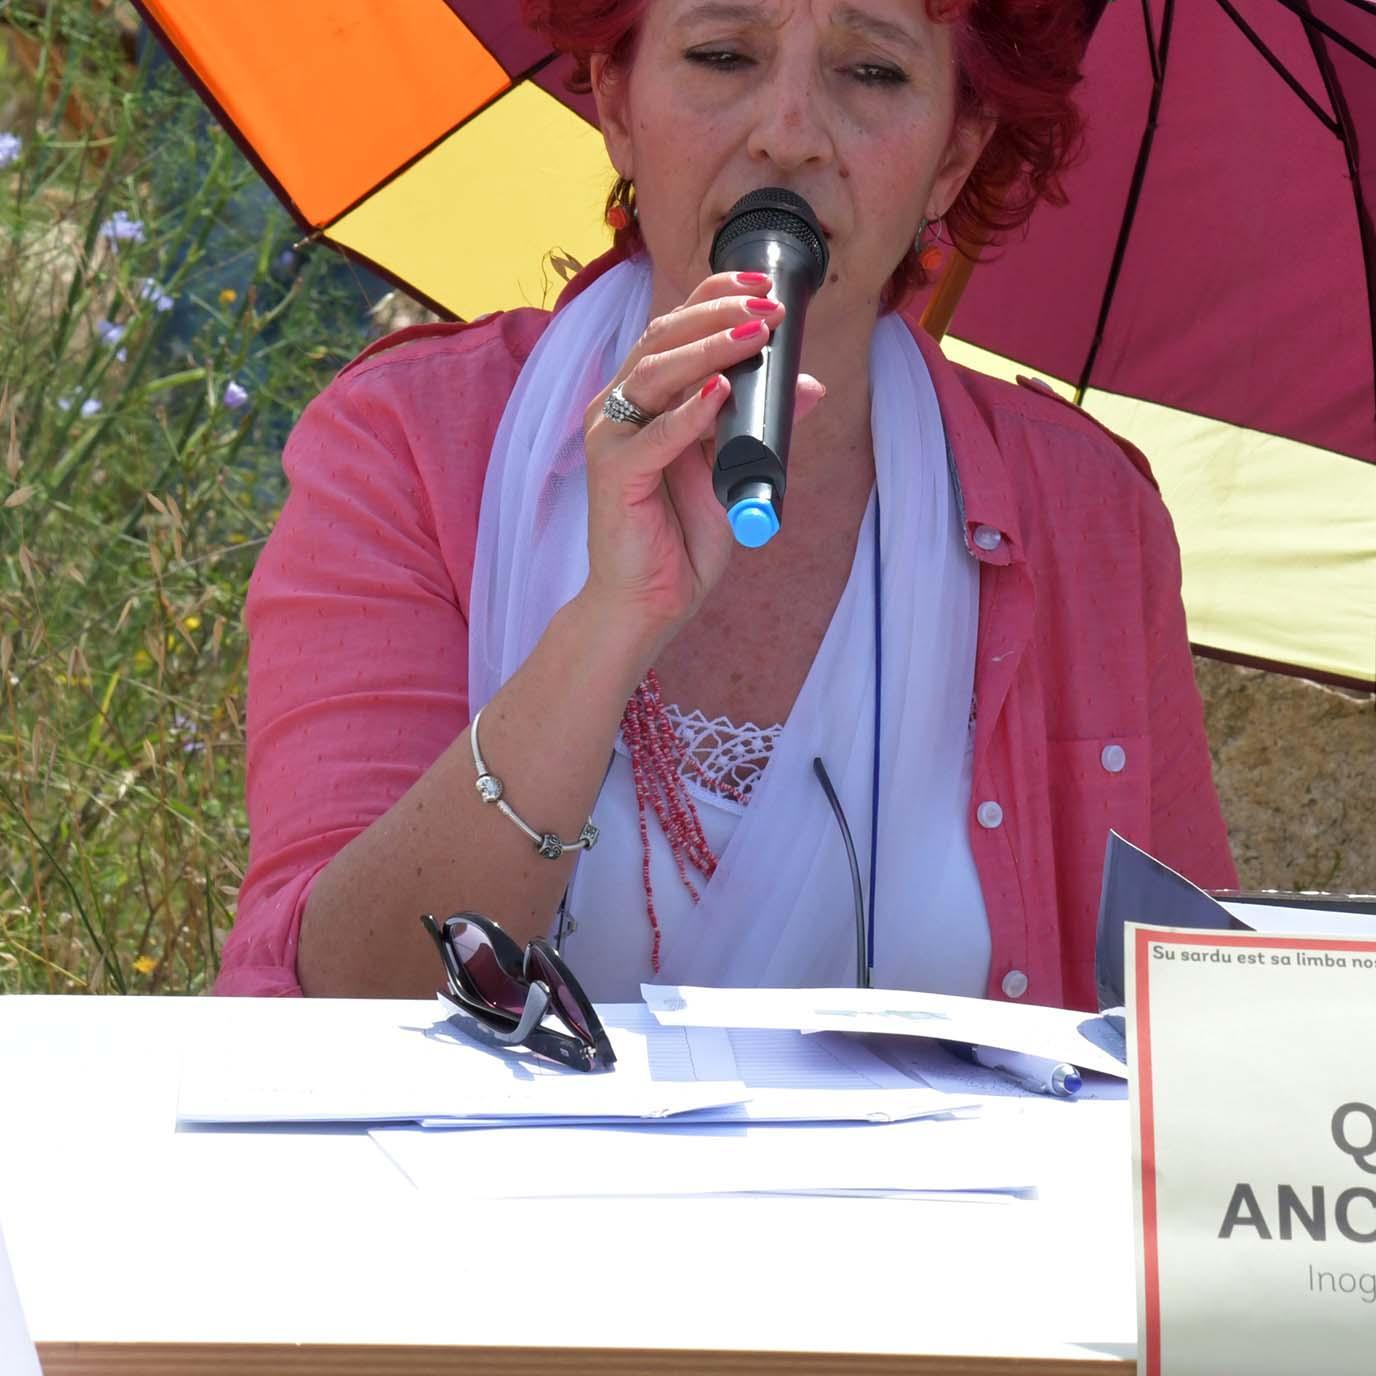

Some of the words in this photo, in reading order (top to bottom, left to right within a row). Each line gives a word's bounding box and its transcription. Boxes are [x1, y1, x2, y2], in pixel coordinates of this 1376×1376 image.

[1152, 944, 1175, 961] Su
[1180, 948, 1232, 964] sardu
[1236, 951, 1266, 966] est
[1270, 954, 1292, 967] sa
[1296, 952, 1347, 968] limba
